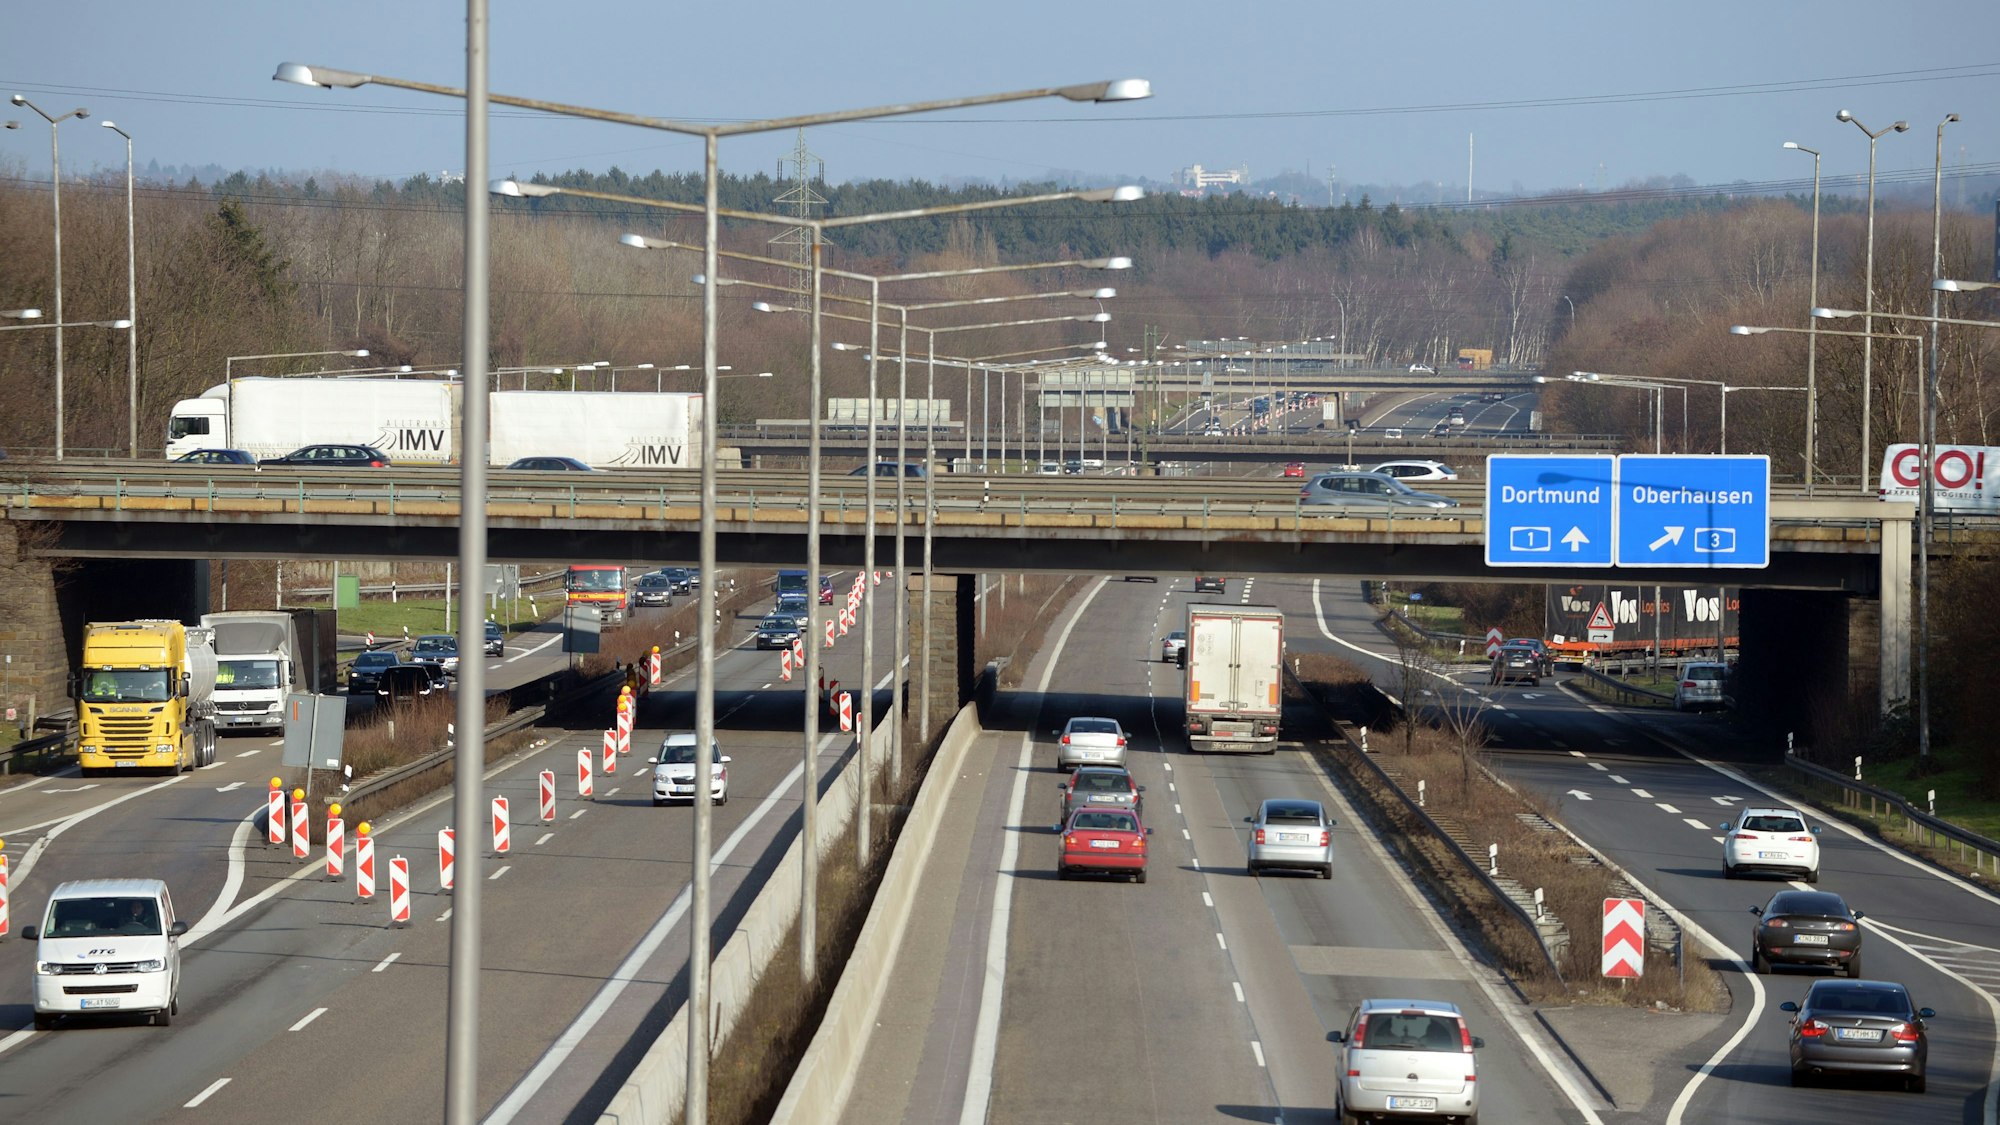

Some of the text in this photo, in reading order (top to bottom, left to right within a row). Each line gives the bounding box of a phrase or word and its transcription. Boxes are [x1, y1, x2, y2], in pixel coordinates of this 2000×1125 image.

[386, 420, 445, 428] ALLTRANS
[399, 429, 444, 451] IMV
[642, 445, 682, 464] IMV
[1891, 448, 1985, 489] GO!
[1502, 486, 1600, 504] Dortmund
[1632, 486, 1753, 504] Oberhausen
[1527, 532, 1534, 547] 1
[1710, 533, 1720, 548] 3
[1561, 596, 1590, 612] Vos
[1611, 591, 1638, 624] Vos
[1683, 590, 1719, 622] Vos
